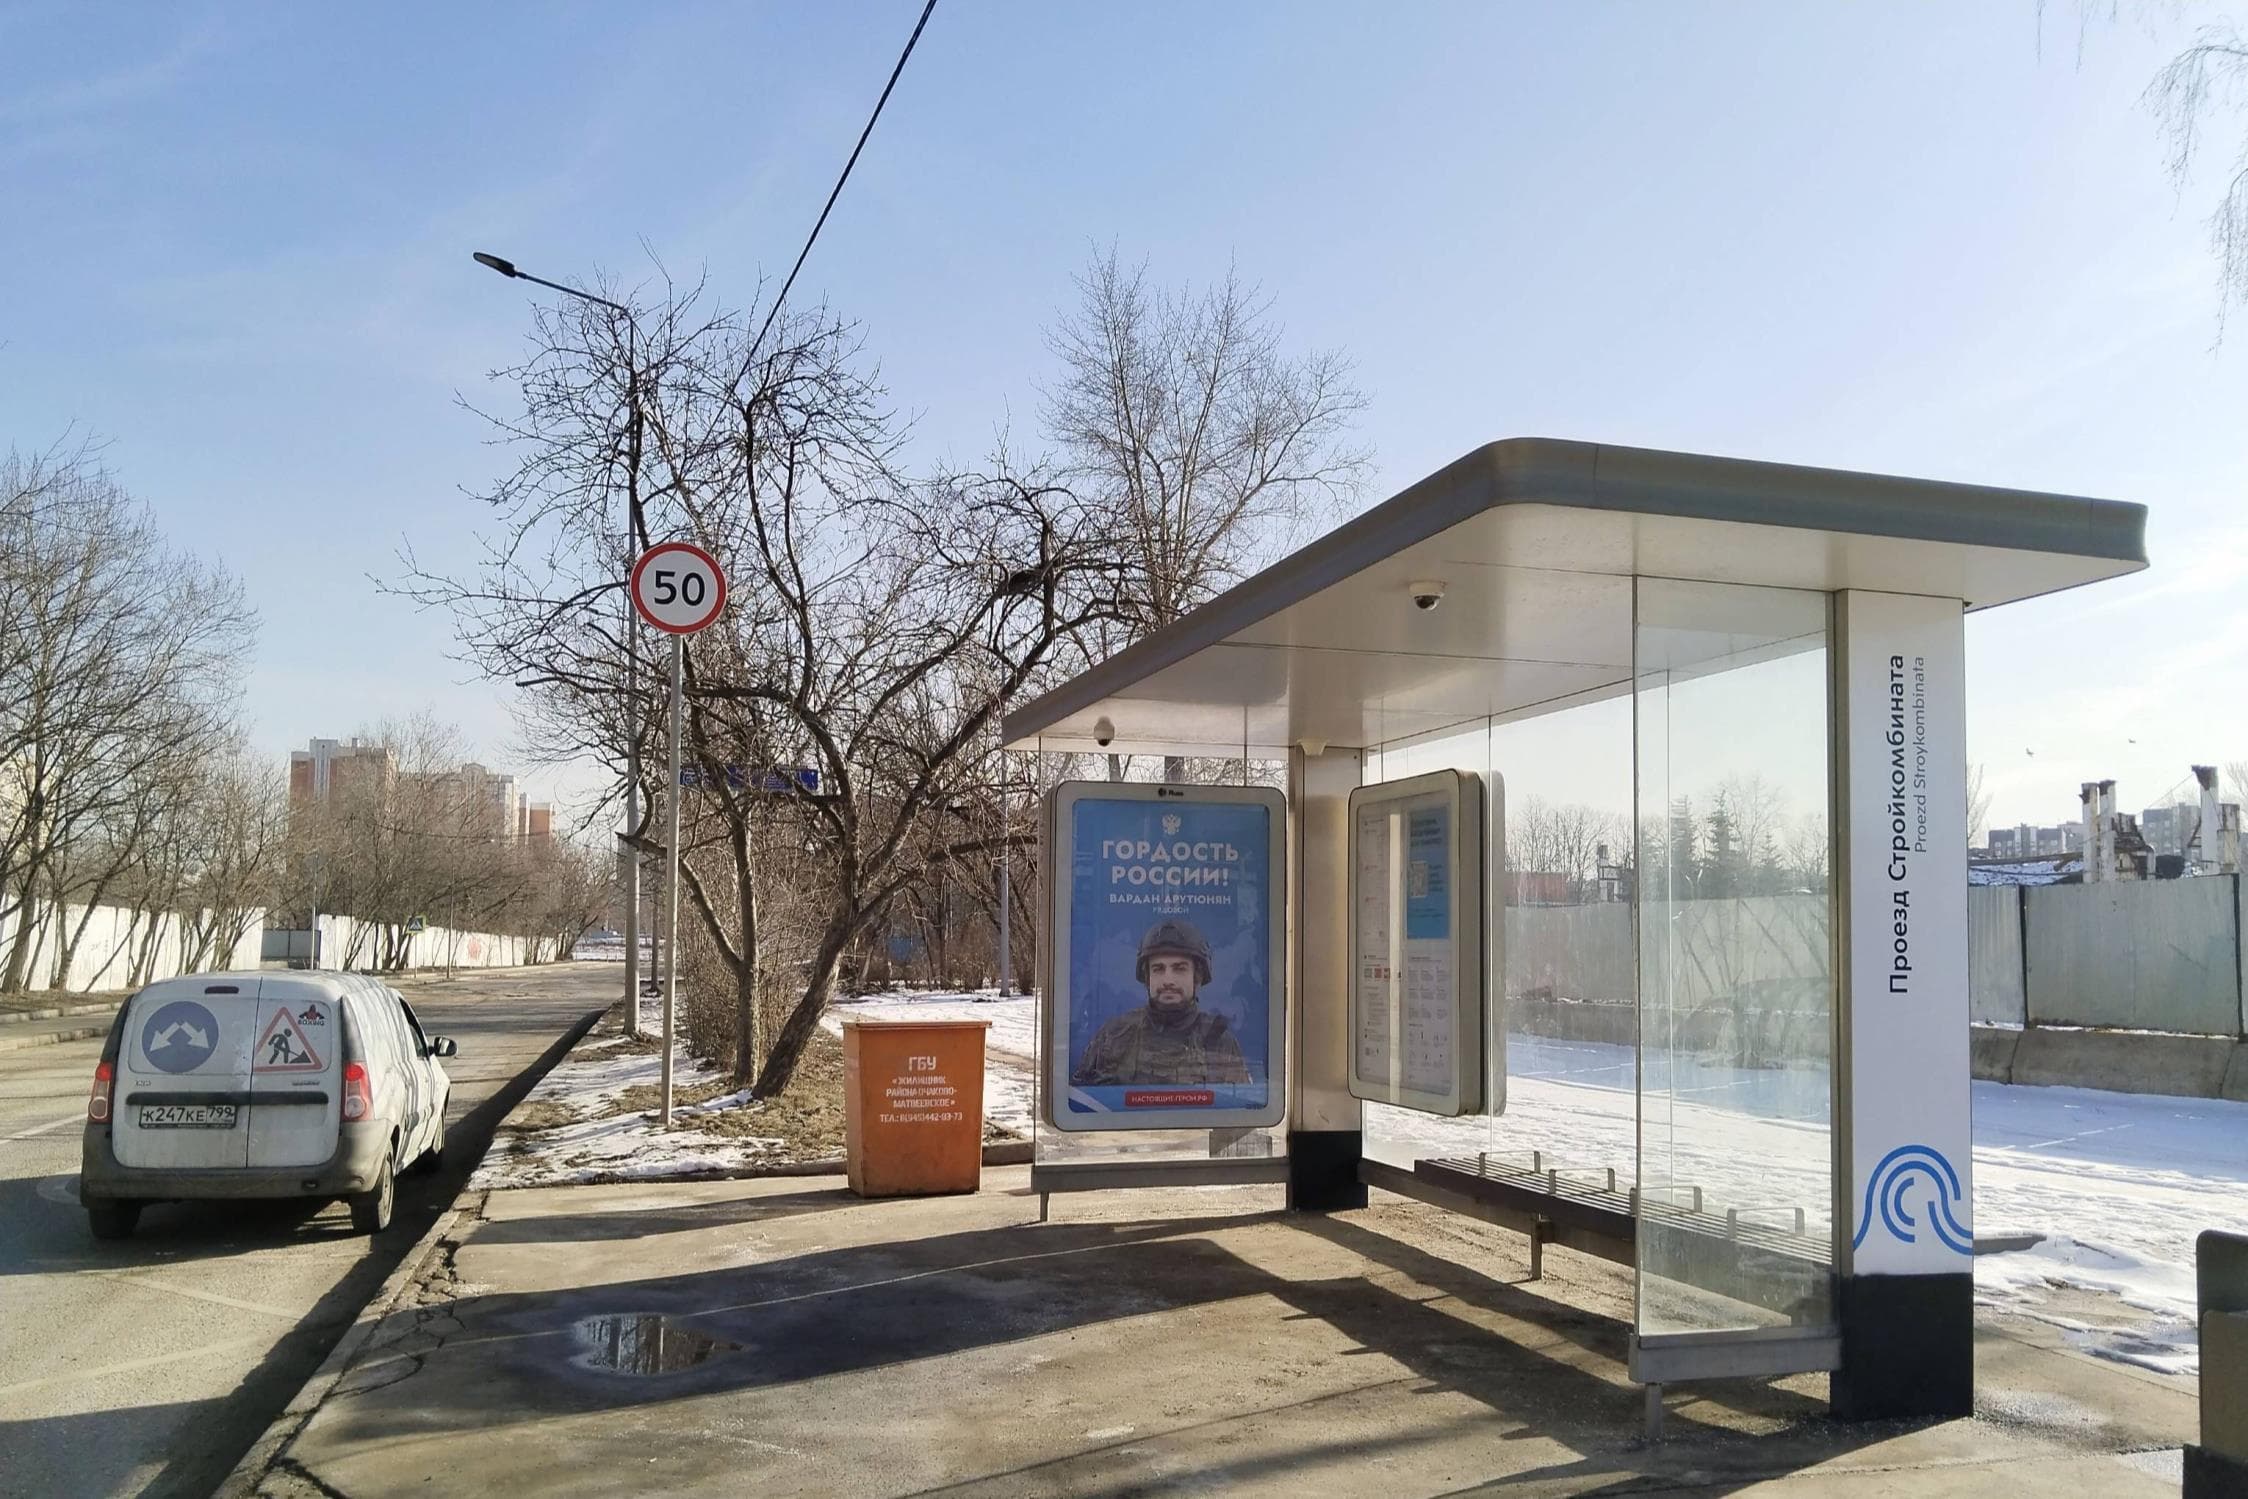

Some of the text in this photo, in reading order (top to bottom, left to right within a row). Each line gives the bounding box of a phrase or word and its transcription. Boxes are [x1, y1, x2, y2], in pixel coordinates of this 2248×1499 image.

[654, 570, 705, 606] 50
[1912, 656, 1929, 853] Proezd Stroykombinata
[1886, 654, 1912, 993] Проезд Стройкомбината
[1102, 840, 1239, 863] ГОРДОСТЬ
[1112, 865, 1230, 887] РОССИИ!
[1109, 894, 1231, 905] ВАРДАН АРУТЮНЯН
[908, 1056, 937, 1071] ГБУ
[145, 1107, 233, 1122] К247КЕ 799
